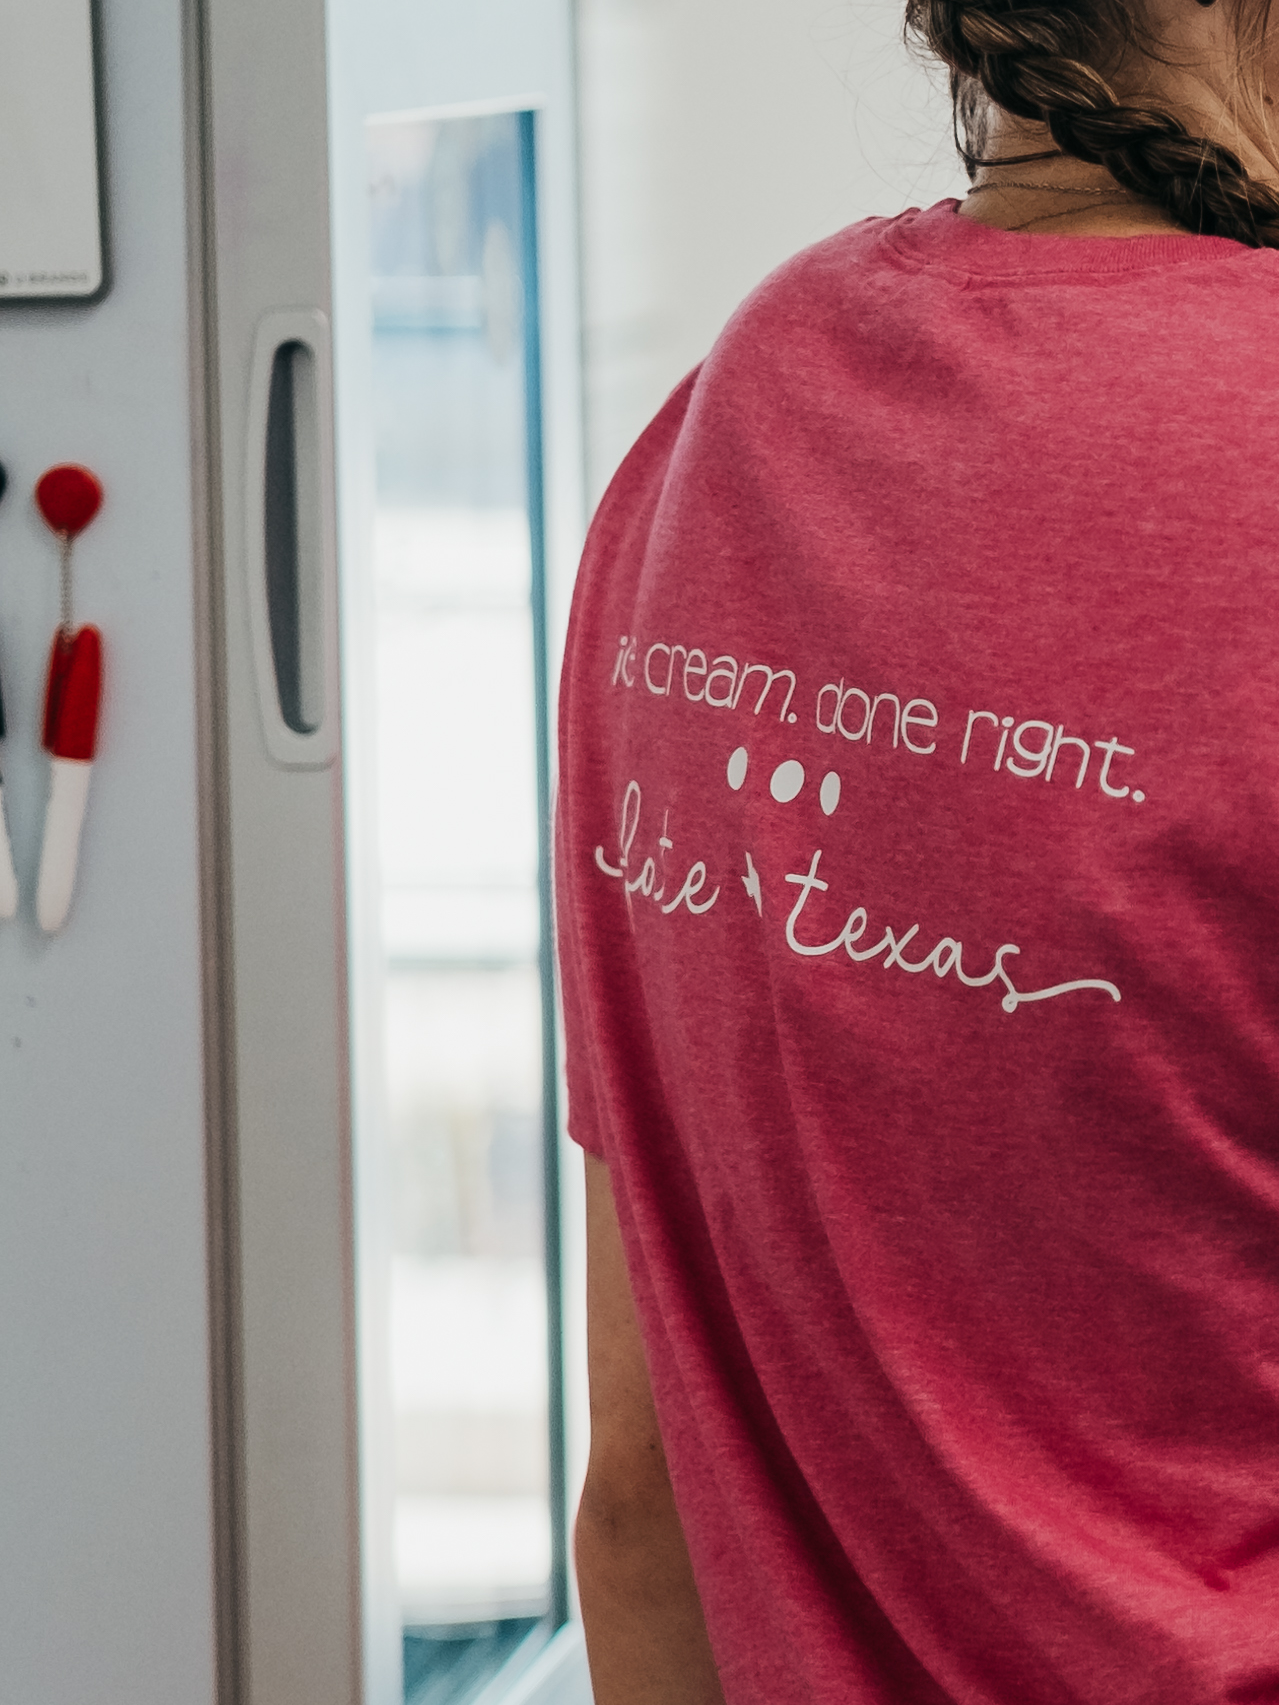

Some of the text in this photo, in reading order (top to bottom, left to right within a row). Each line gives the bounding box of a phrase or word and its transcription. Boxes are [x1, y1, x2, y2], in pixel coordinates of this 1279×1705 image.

[645, 643, 798, 724] cream.
[816, 676, 939, 755] done
[960, 708, 1146, 803] right.
[784, 849, 1122, 1014] texas
